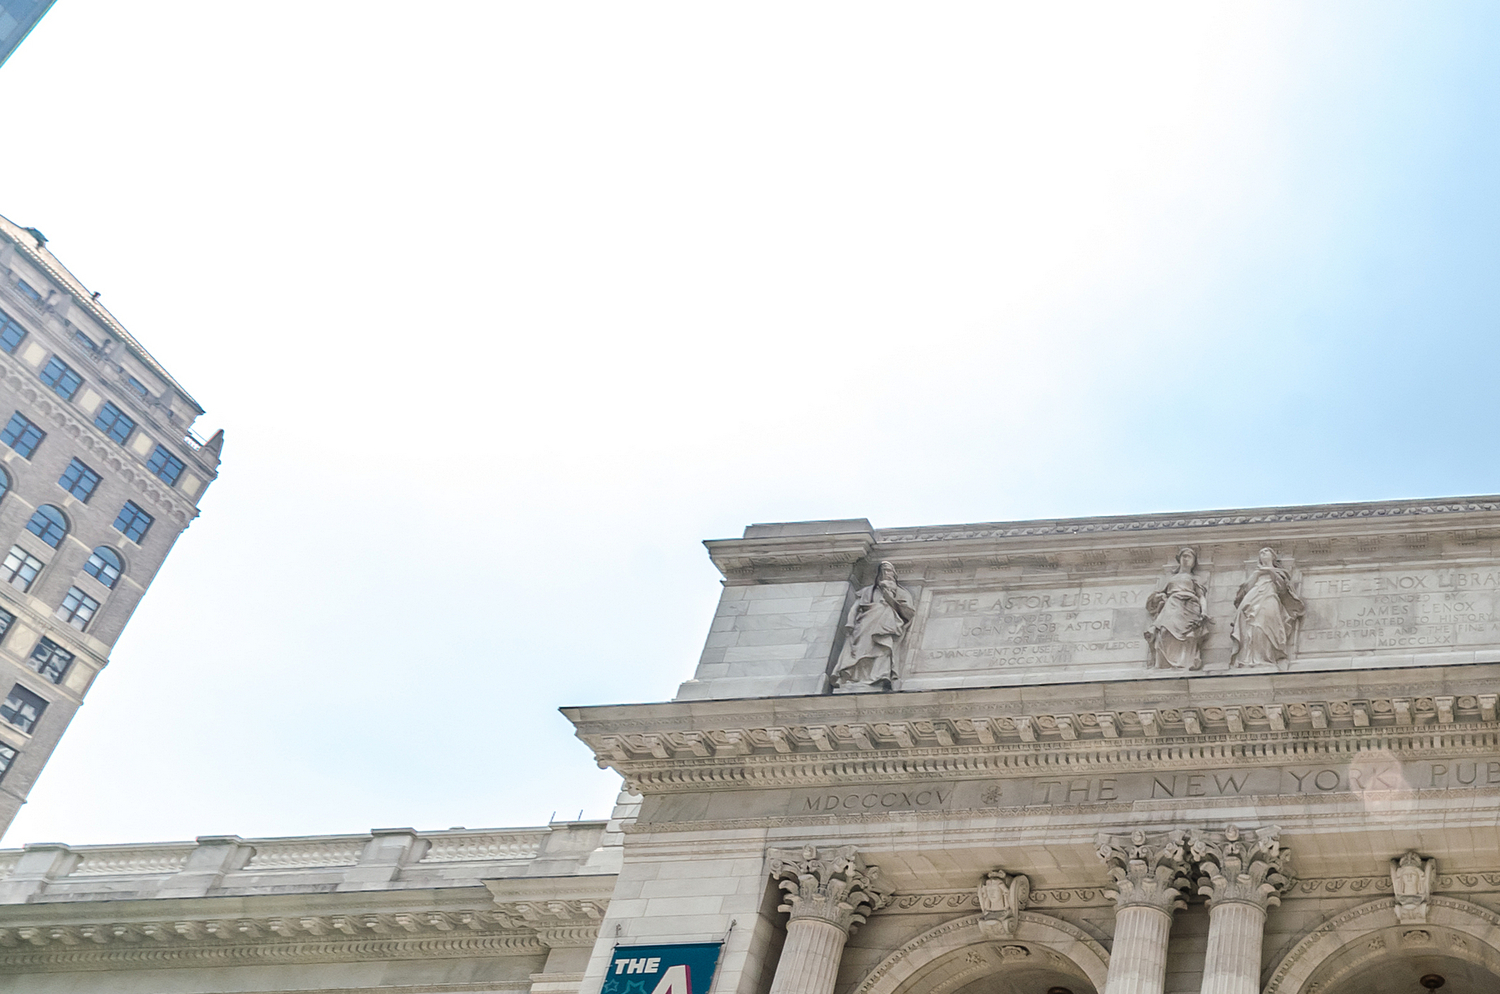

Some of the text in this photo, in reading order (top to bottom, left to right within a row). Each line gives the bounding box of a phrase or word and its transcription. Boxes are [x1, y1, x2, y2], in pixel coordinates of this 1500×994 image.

[1314, 579, 1351, 593] THE
[1361, 575, 1429, 591] LENOX
[942, 590, 1143, 613] THE ASTOR LIBRARY
[1374, 592, 1460, 604] FOUNDED BY
[1357, 601, 1475, 617] JAMES LENOX
[999, 612, 1080, 624] FOUNDED BY
[1339, 616, 1405, 628] DEDICATED
[1415, 616, 1430, 624] TO
[961, 620, 1111, 637] JOHN JACOB ASTOR
[1307, 628, 1384, 640] LITERATURE
[1394, 626, 1418, 635] AND
[1427, 625, 1450, 634] THE
[1458, 623, 1485, 633] FINE
[1006, 634, 1060, 644] FOR THE
[1377, 635, 1451, 646] MDCCCLXX
[927, 641, 1140, 660] ADVANCEMENT OF USEFUL KNOWLEDGE
[802, 790, 953, 812] MDCCCXCV
[1038, 778, 1119, 805] THE
[1150, 772, 1251, 799] NEW
[1288, 767, 1392, 793] YORK
[614, 957, 661, 975] THE
